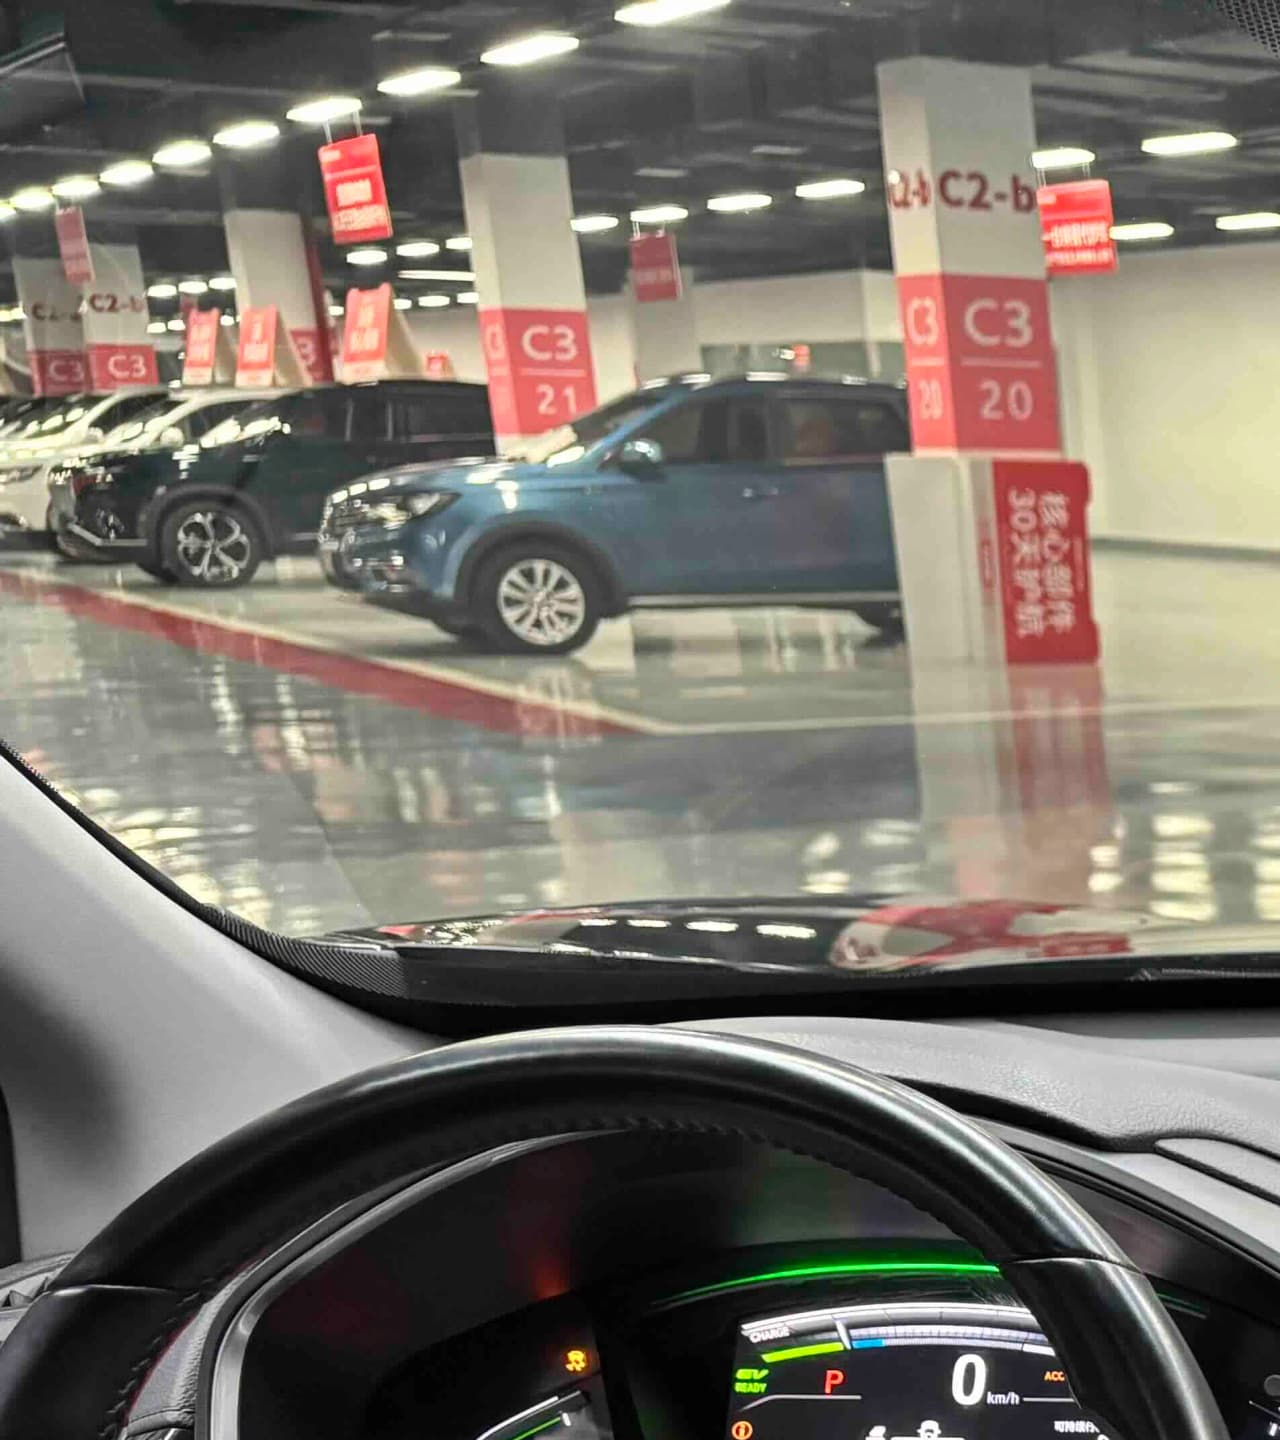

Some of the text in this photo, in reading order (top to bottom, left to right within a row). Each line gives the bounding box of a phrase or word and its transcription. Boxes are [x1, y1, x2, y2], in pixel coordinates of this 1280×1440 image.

[939, 169, 1037, 213] C2-b
[907, 298, 939, 345] C3
[964, 298, 1033, 348] C3
[521, 324, 578, 361] C3
[49, 359, 85, 382] C3
[107, 355, 147, 379] C3
[536, 383, 577, 416] 21
[979, 379, 1033, 421] 20
[750, 1326, 790, 1343] CHARGE
[735, 1382, 767, 1393] READY
[824, 1369, 844, 1394] P
[951, 1353, 1020, 1406] 0 km/h
[1044, 1371, 1065, 1381] ACC
